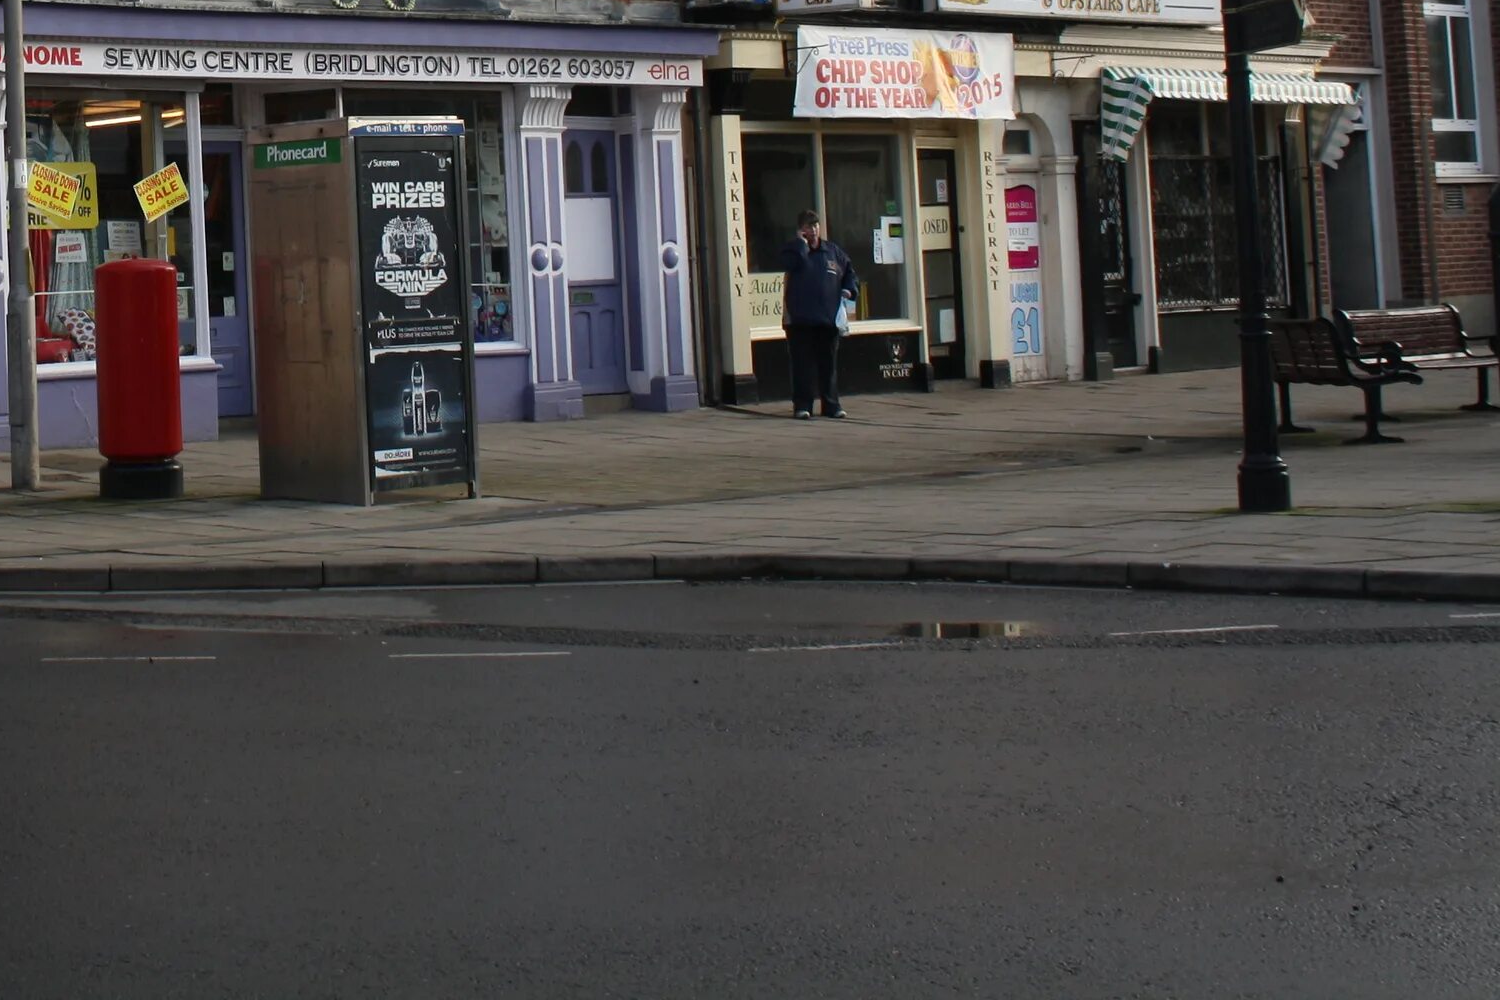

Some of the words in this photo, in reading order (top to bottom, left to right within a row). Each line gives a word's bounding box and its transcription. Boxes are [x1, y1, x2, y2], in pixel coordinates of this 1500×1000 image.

[828, 35, 865, 55] Free
[865, 36, 909, 57] Press
[102, 47, 197, 72] SEWING
[203, 51, 294, 74] CENTRE
[303, 53, 459, 79] (BRIDLINGTON)
[567, 58, 635, 78] 603057
[646, 60, 690, 82] elna
[815, 58, 866, 83] CHIP
[869, 60, 923, 85] SHOP
[814, 87, 841, 108] OF
[844, 88, 877, 109] THE
[879, 88, 927, 109] YEAR
[957, 73, 1002, 109] 2015
[366, 124, 392, 133] e-mail
[399, 125, 416, 133] text
[423, 124, 449, 134] phone
[266, 141, 328, 163] Phonecard
[32, 163, 60, 185] CLOSING
[60, 174, 79, 193] DOWN
[137, 174, 162, 197] CLOSING
[160, 165, 179, 183] DOWN
[371, 182, 400, 193] WIN
[404, 181, 445, 193] CASH
[34, 180, 70, 203] SALE
[145, 180, 179, 206] SALE
[371, 192, 446, 209] PRIZES
[78, 206, 91, 217] OFF
[983, 151, 1000, 291] RESTAURANT
[728, 151, 745, 298] TAKEAWAY
[921, 218, 948, 235] OSED
[375, 268, 447, 283] FORMULA
[749, 276, 784, 295] Audr
[397, 281, 426, 293] WIN
[750, 301, 769, 317] ish
[772, 302, 782, 315] &
[1010, 307, 1041, 354] £1
[883, 369, 891, 378] IN
[892, 368, 910, 377] CAFE
